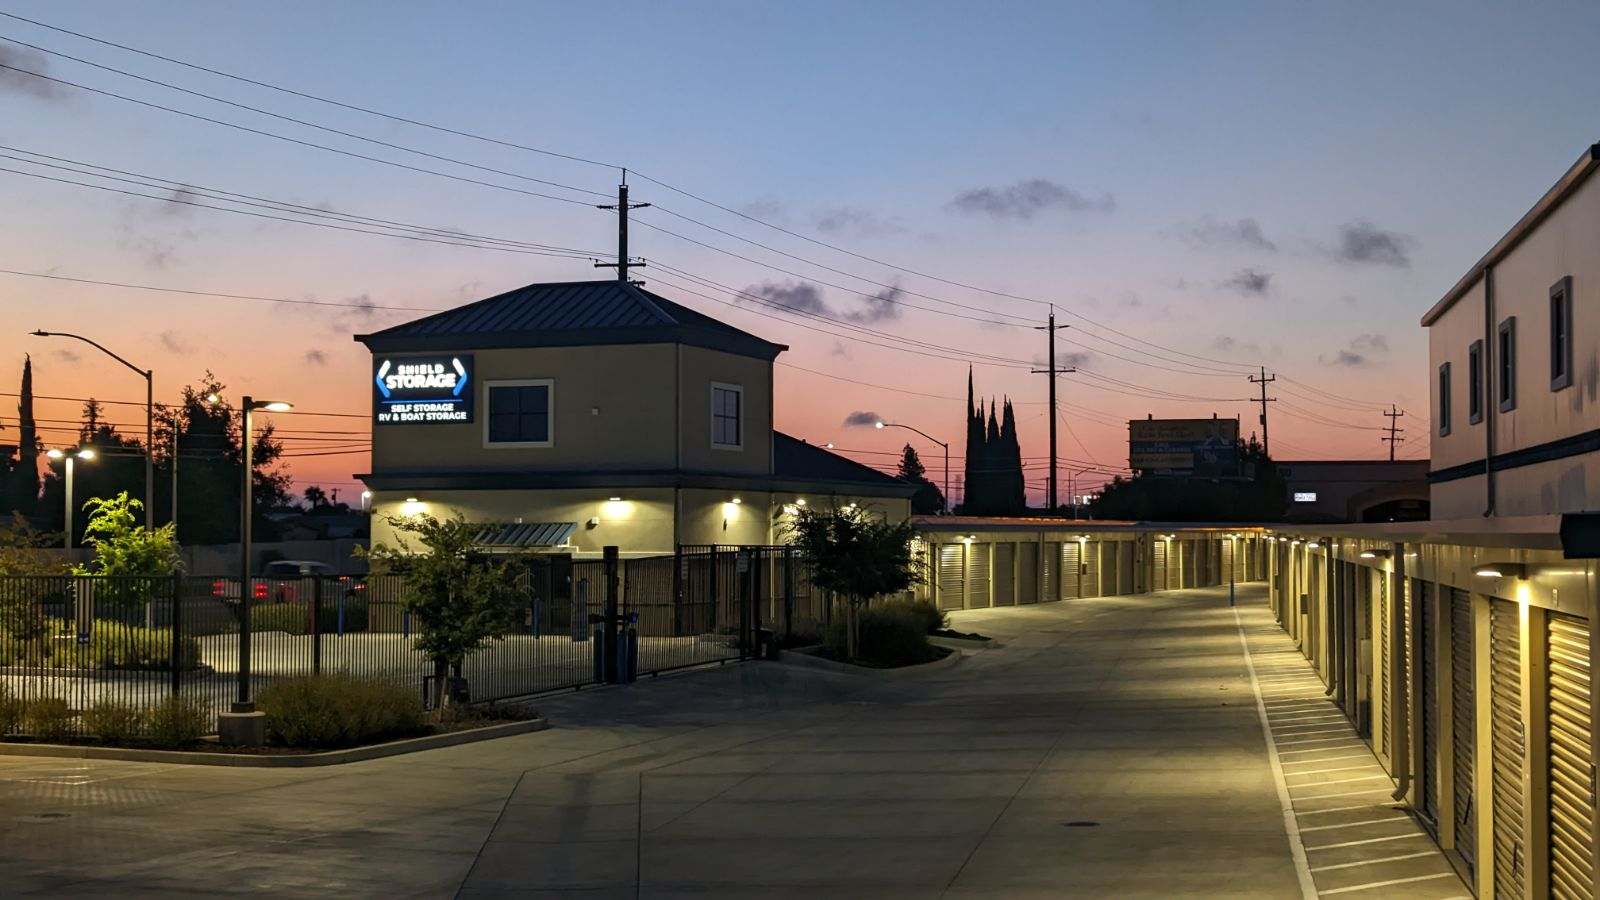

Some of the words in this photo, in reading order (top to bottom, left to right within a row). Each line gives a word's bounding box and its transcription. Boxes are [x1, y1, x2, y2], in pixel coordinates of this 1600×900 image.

[398, 364, 444, 375] SHIELD
[386, 373, 456, 389] STORAGE
[391, 404, 412, 412] SELF
[413, 404, 454, 412] STORAGE
[379, 413, 391, 421] RV
[392, 413, 399, 421] &
[426, 412, 467, 420] STORAGE
